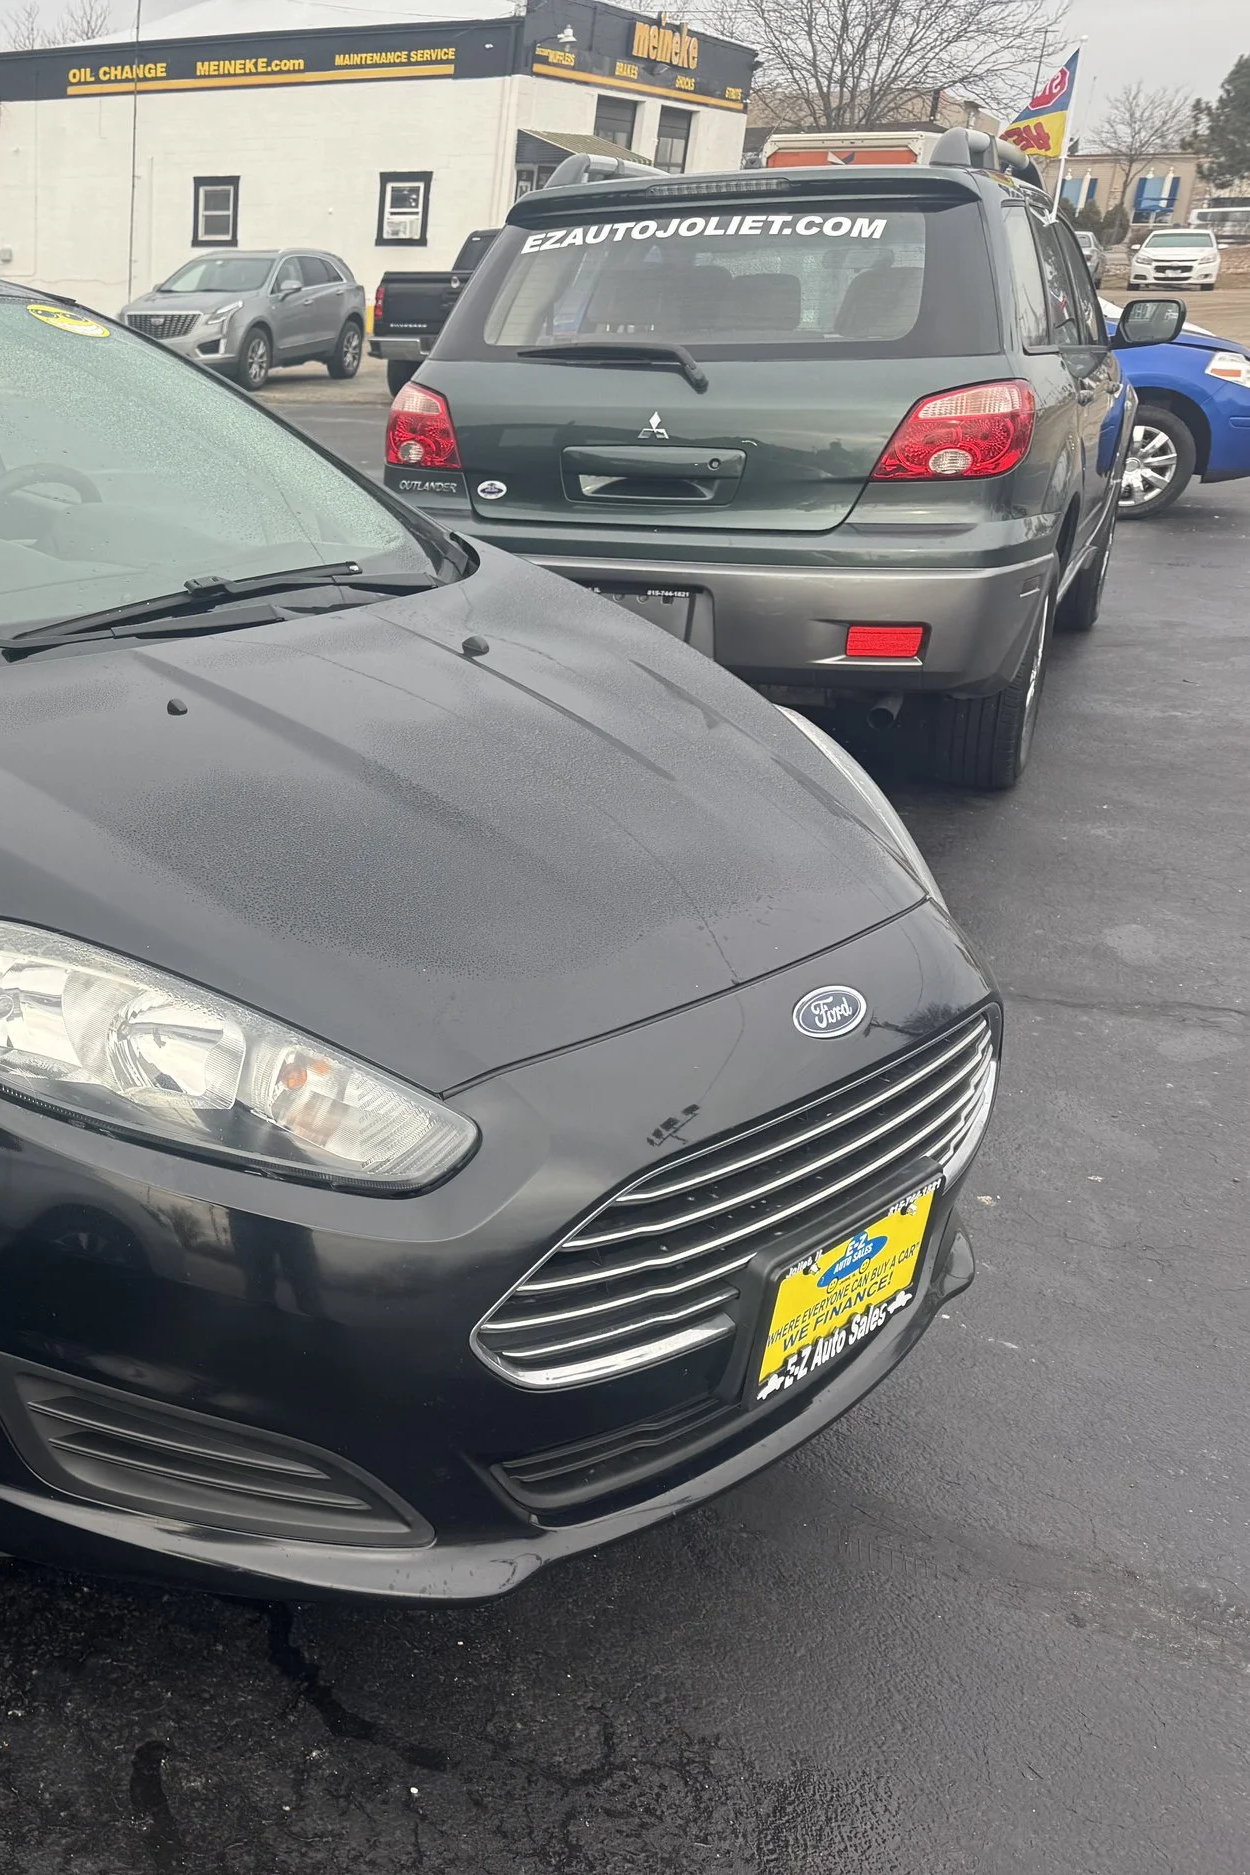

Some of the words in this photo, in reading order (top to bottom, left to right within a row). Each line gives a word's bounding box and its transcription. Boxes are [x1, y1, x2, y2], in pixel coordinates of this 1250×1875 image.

[335, 51, 409, 66] MAINTENANCE
[410, 48, 456, 62] SERVICE
[632, 12, 699, 70] meineke
[68, 68, 95, 83] OIL
[99, 63, 167, 80] CHANGE
[196, 58, 305, 76] MEINEKE.com
[520, 215, 888, 254] EZAUTOJOLIET.COM
[399, 480, 457, 493] OUTLANDER
[811, 996, 852, 1028] Ford
[833, 1255, 853, 1275] AUTO
[851, 1243, 874, 1263] SALES
[845, 1233, 868, 1257] E-Z
[767, 1315, 801, 1347] WHERE
[801, 1287, 850, 1325] EVERYONE
[850, 1276, 868, 1293] CAN
[870, 1263, 889, 1285] BUY
[887, 1256, 897, 1271] A
[783, 1328, 810, 1351] WE
[813, 1271, 894, 1330] FINANCE!
[784, 1345, 812, 1389] E-Z
[810, 1330, 846, 1371] Auto
[848, 1303, 888, 1346] Sales
